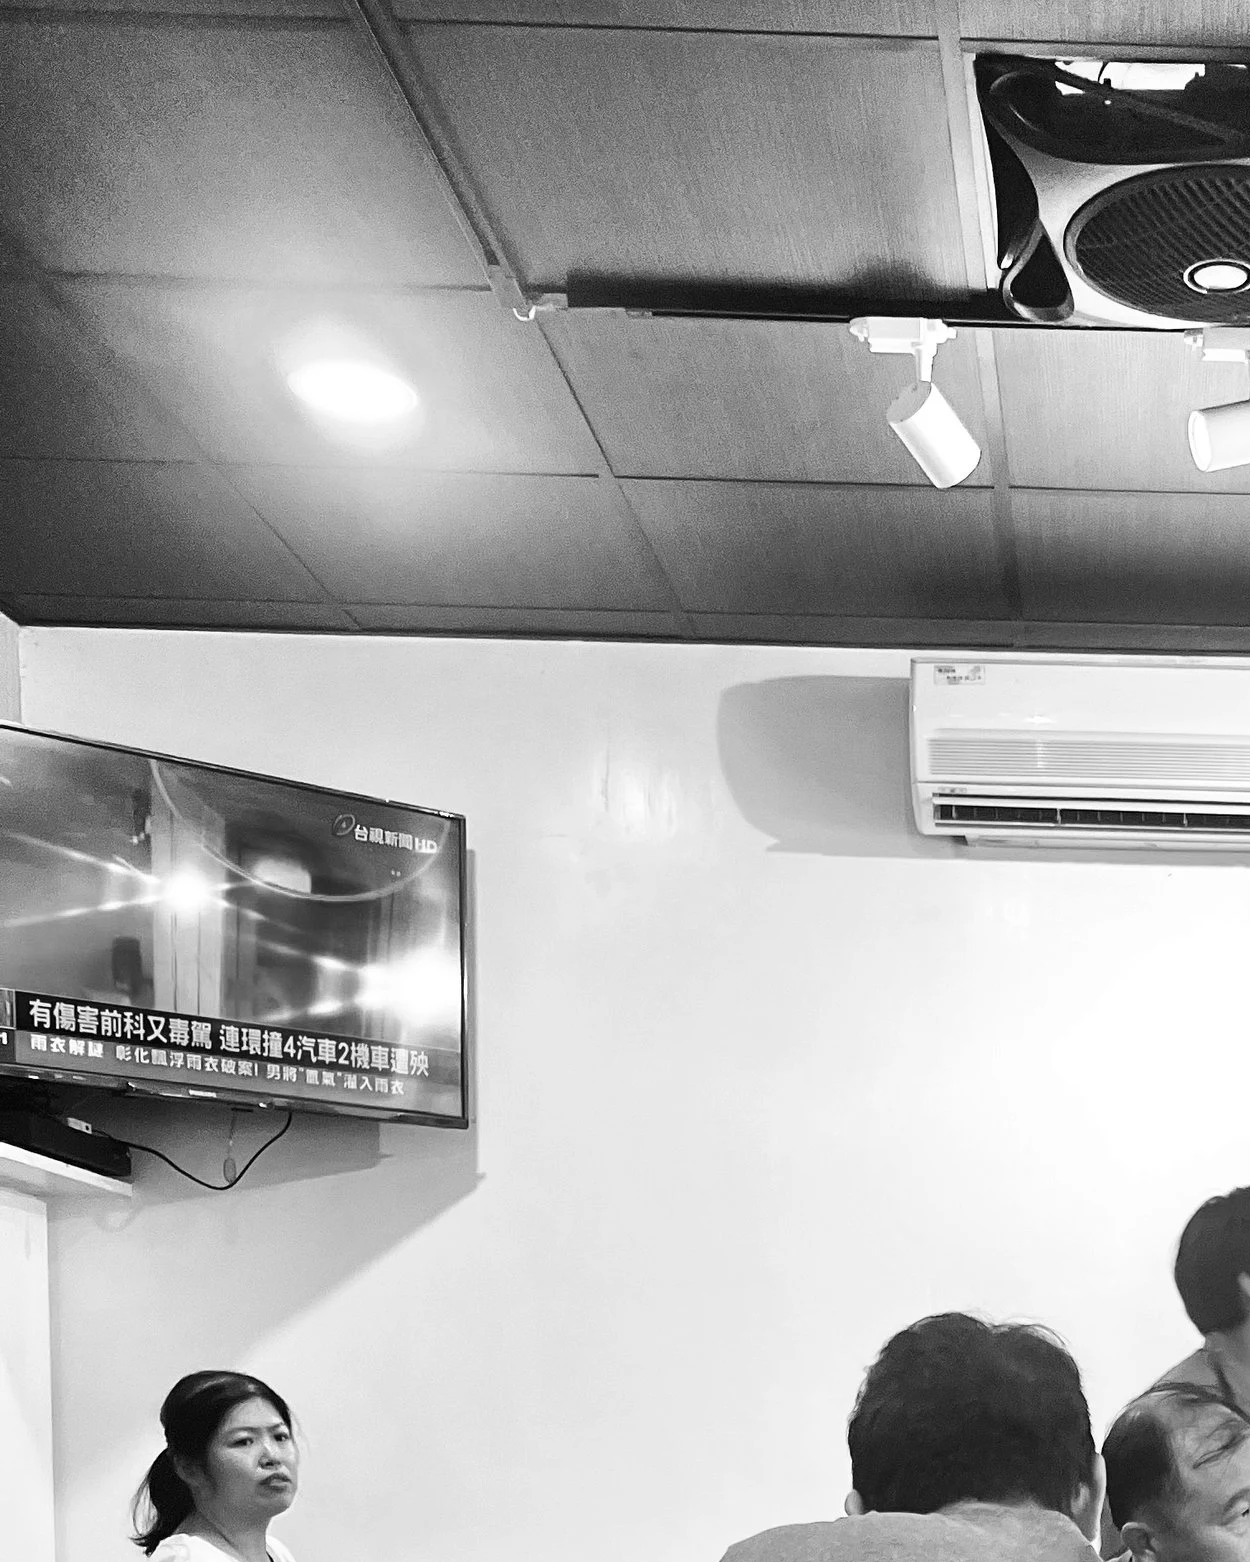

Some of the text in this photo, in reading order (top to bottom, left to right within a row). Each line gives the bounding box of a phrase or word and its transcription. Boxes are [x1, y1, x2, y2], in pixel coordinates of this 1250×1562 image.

[29, 999, 429, 1077] 有傷害前科又毒駕 連環撞4汽車2機車遭殃
